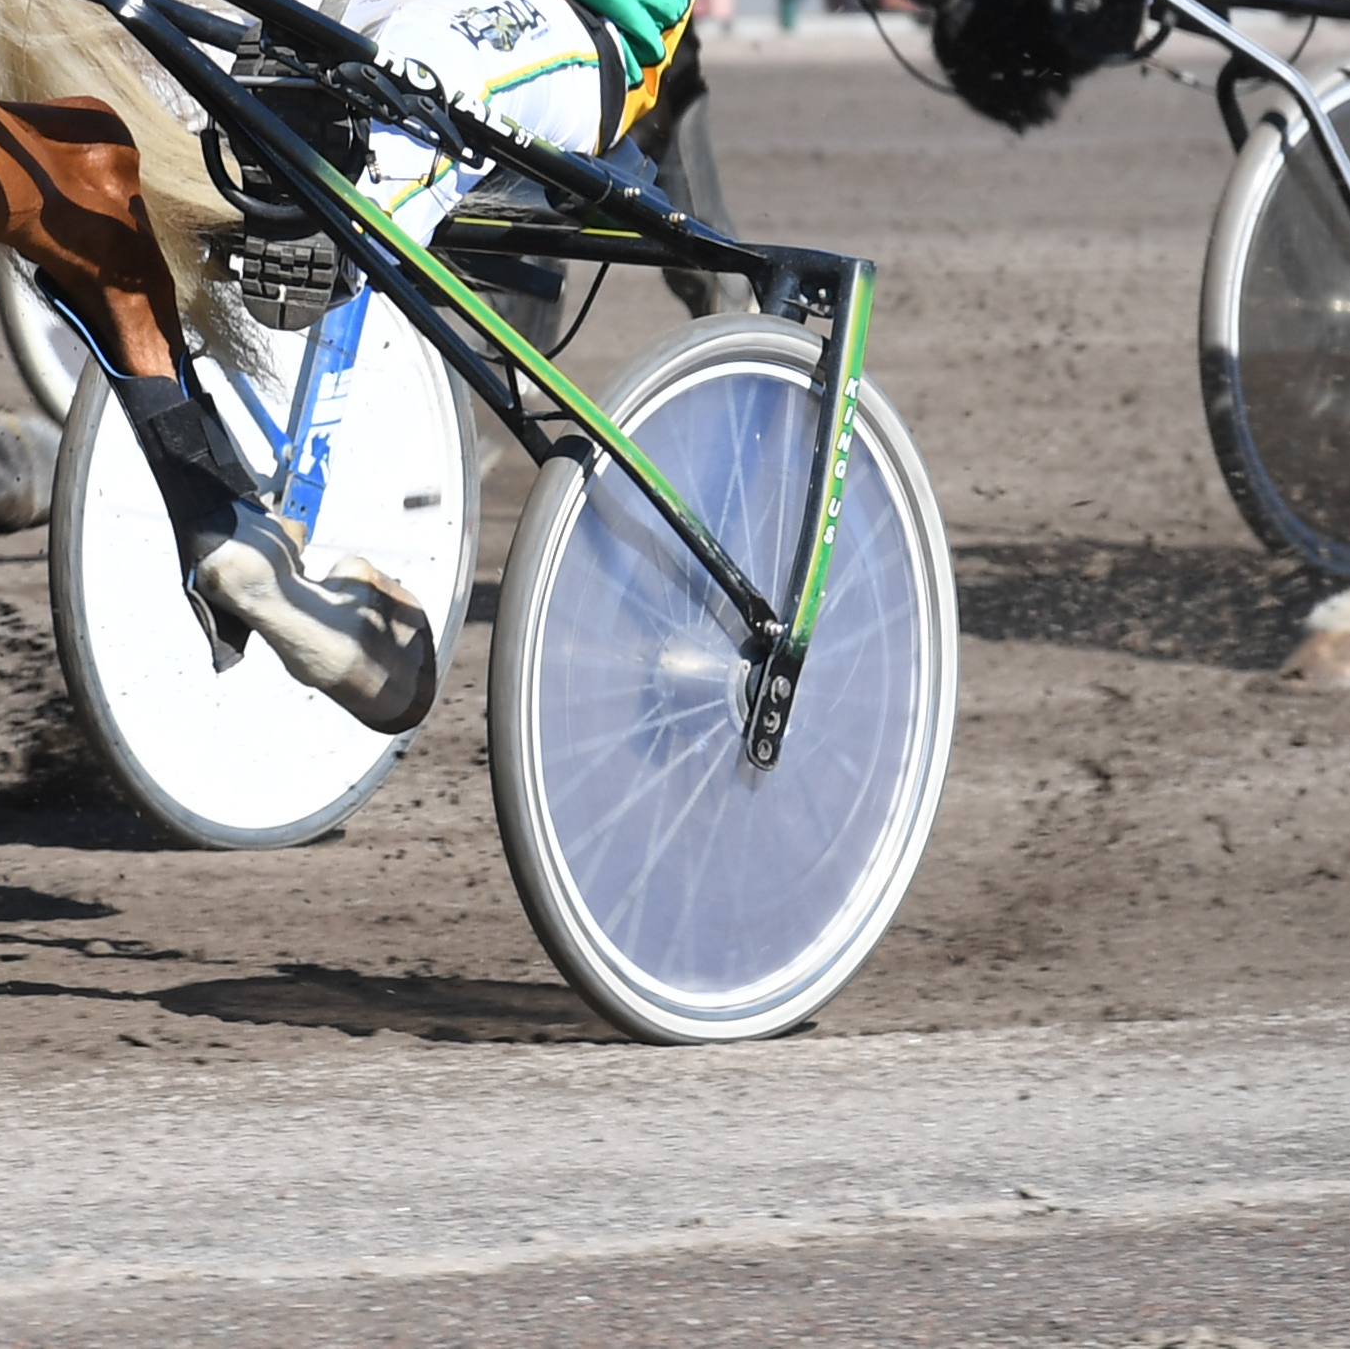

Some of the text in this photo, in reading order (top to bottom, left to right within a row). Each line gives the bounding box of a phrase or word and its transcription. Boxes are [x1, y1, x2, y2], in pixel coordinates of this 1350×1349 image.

[514, 126, 534, 149] ST
[823, 377, 859, 545] KING US
